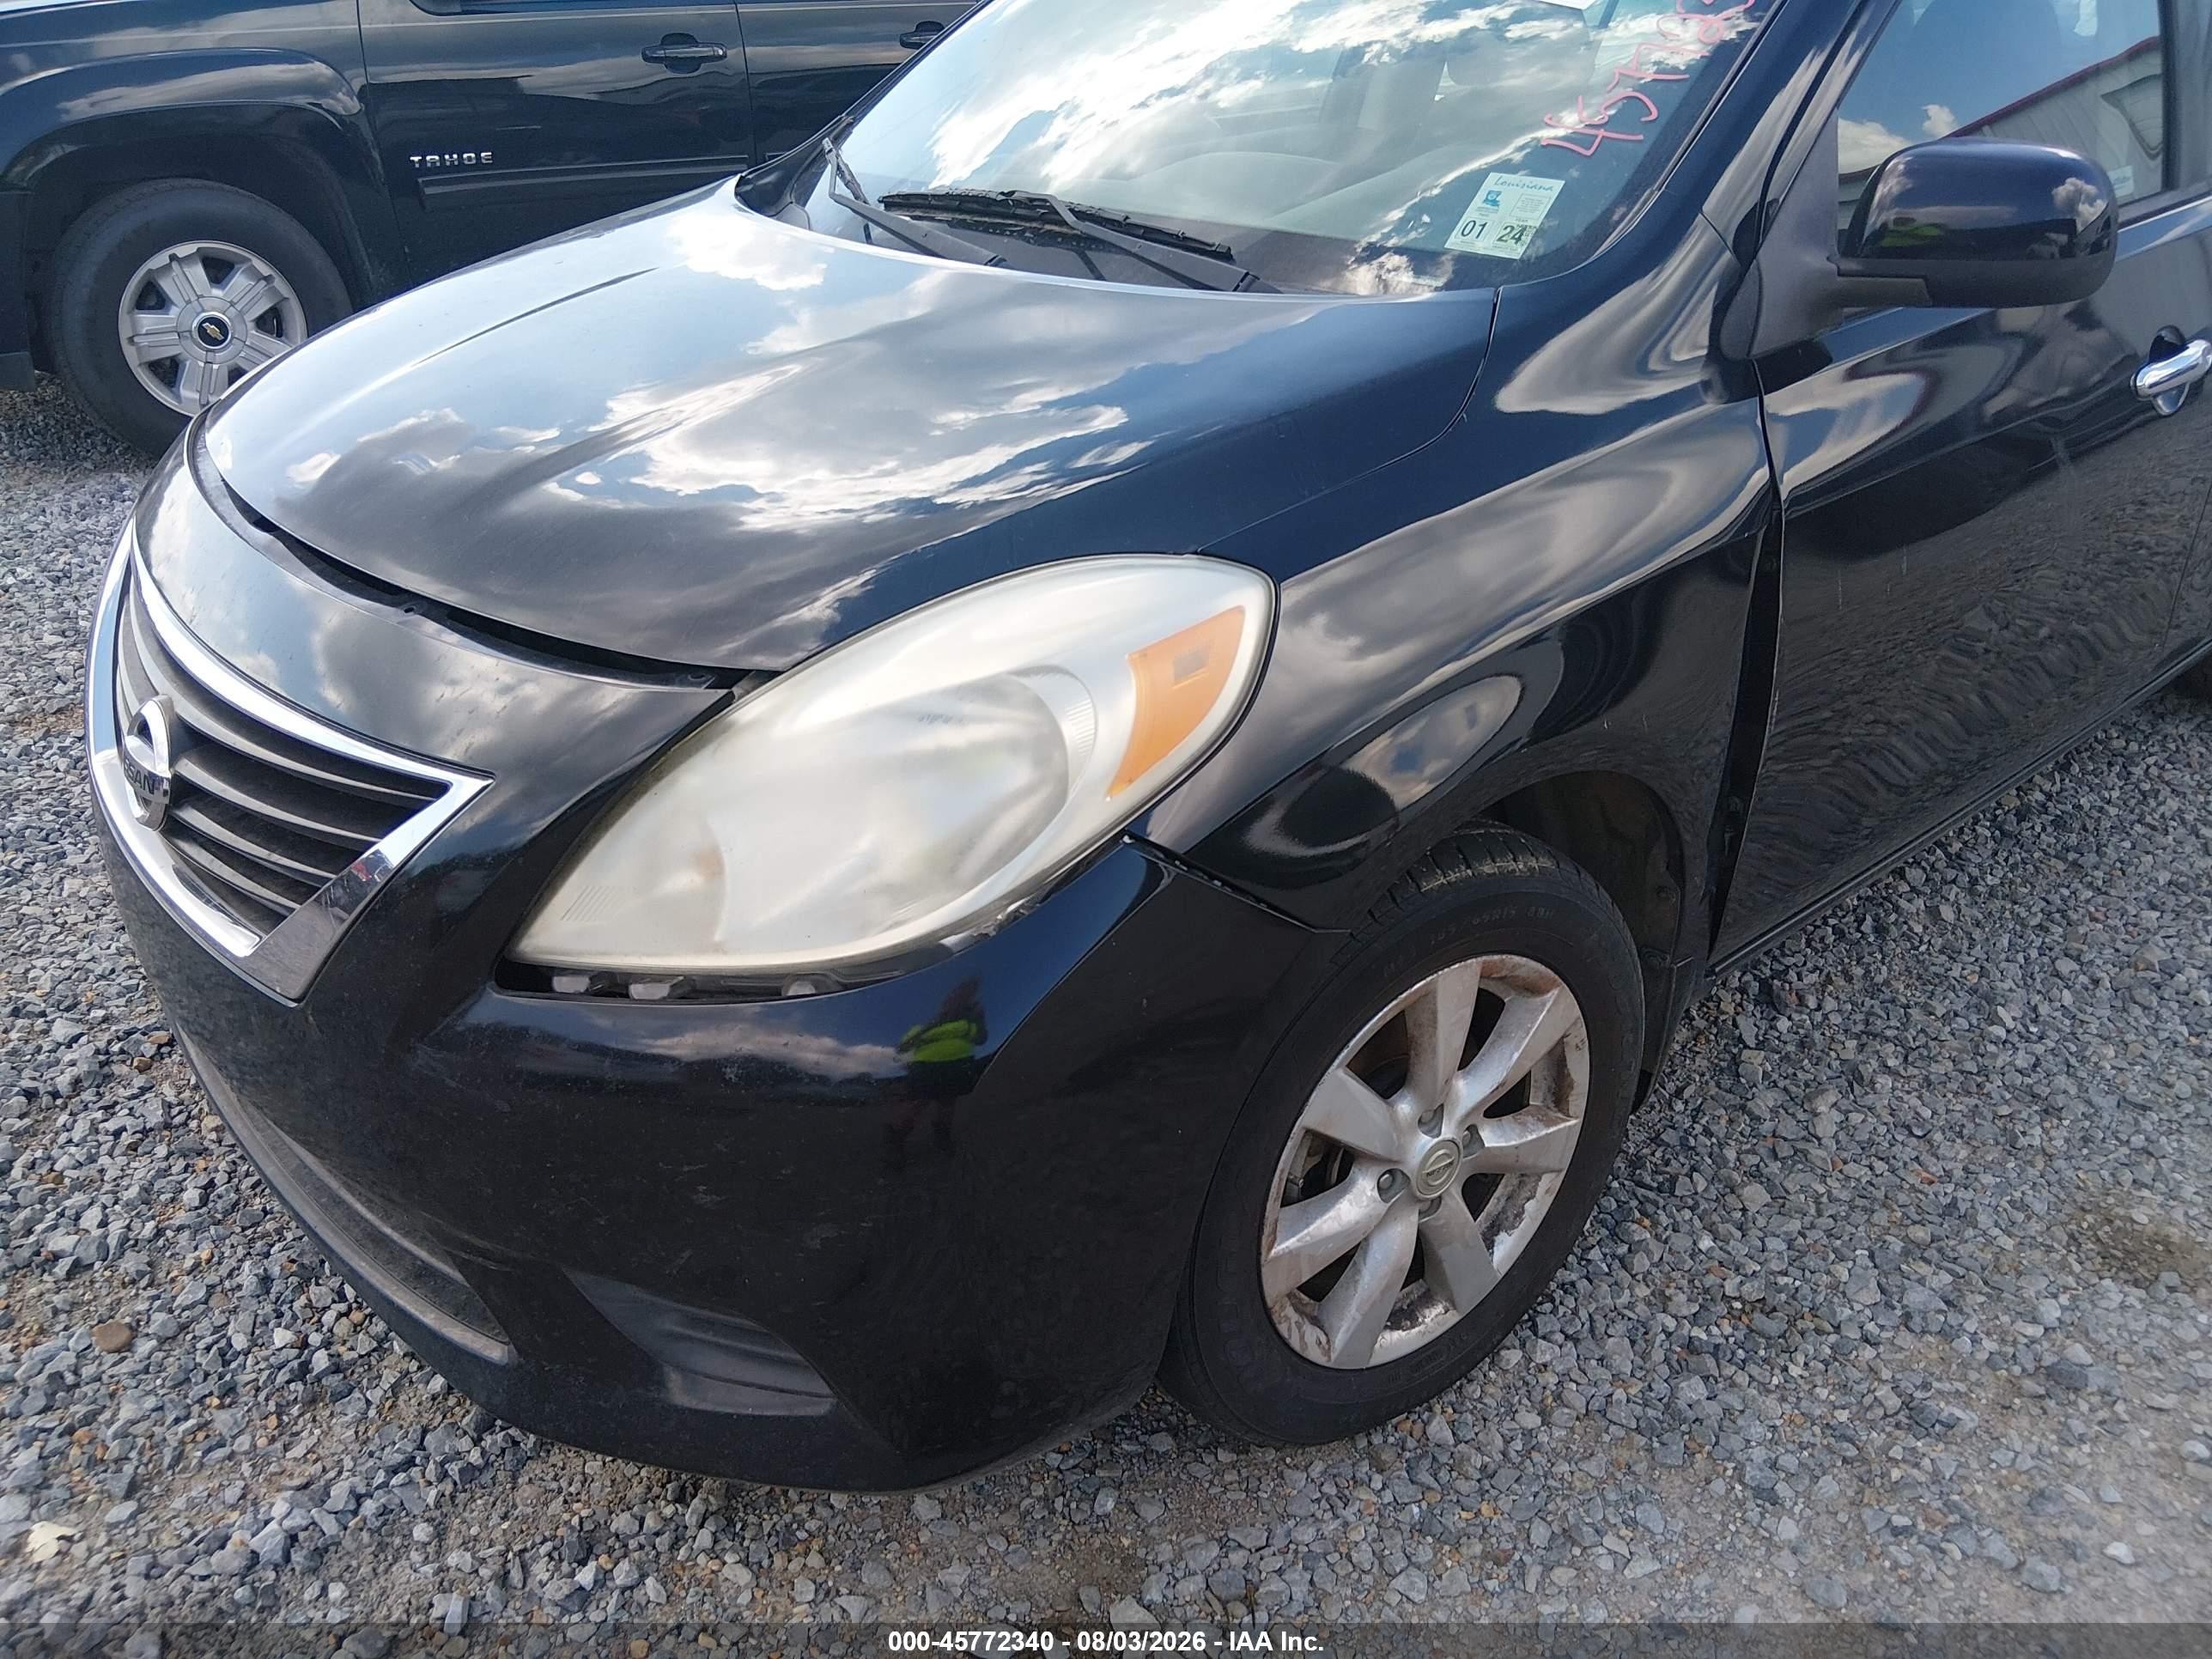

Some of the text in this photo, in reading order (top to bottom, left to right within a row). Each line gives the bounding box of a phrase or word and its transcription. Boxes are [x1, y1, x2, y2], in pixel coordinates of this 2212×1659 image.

[1540, 0, 1754, 156] 45772
[410, 152, 493, 168] TAHOE
[1494, 175, 1553, 192] Louisiana
[1461, 221, 1487, 240] 01
[1497, 225, 1525, 246] 24
